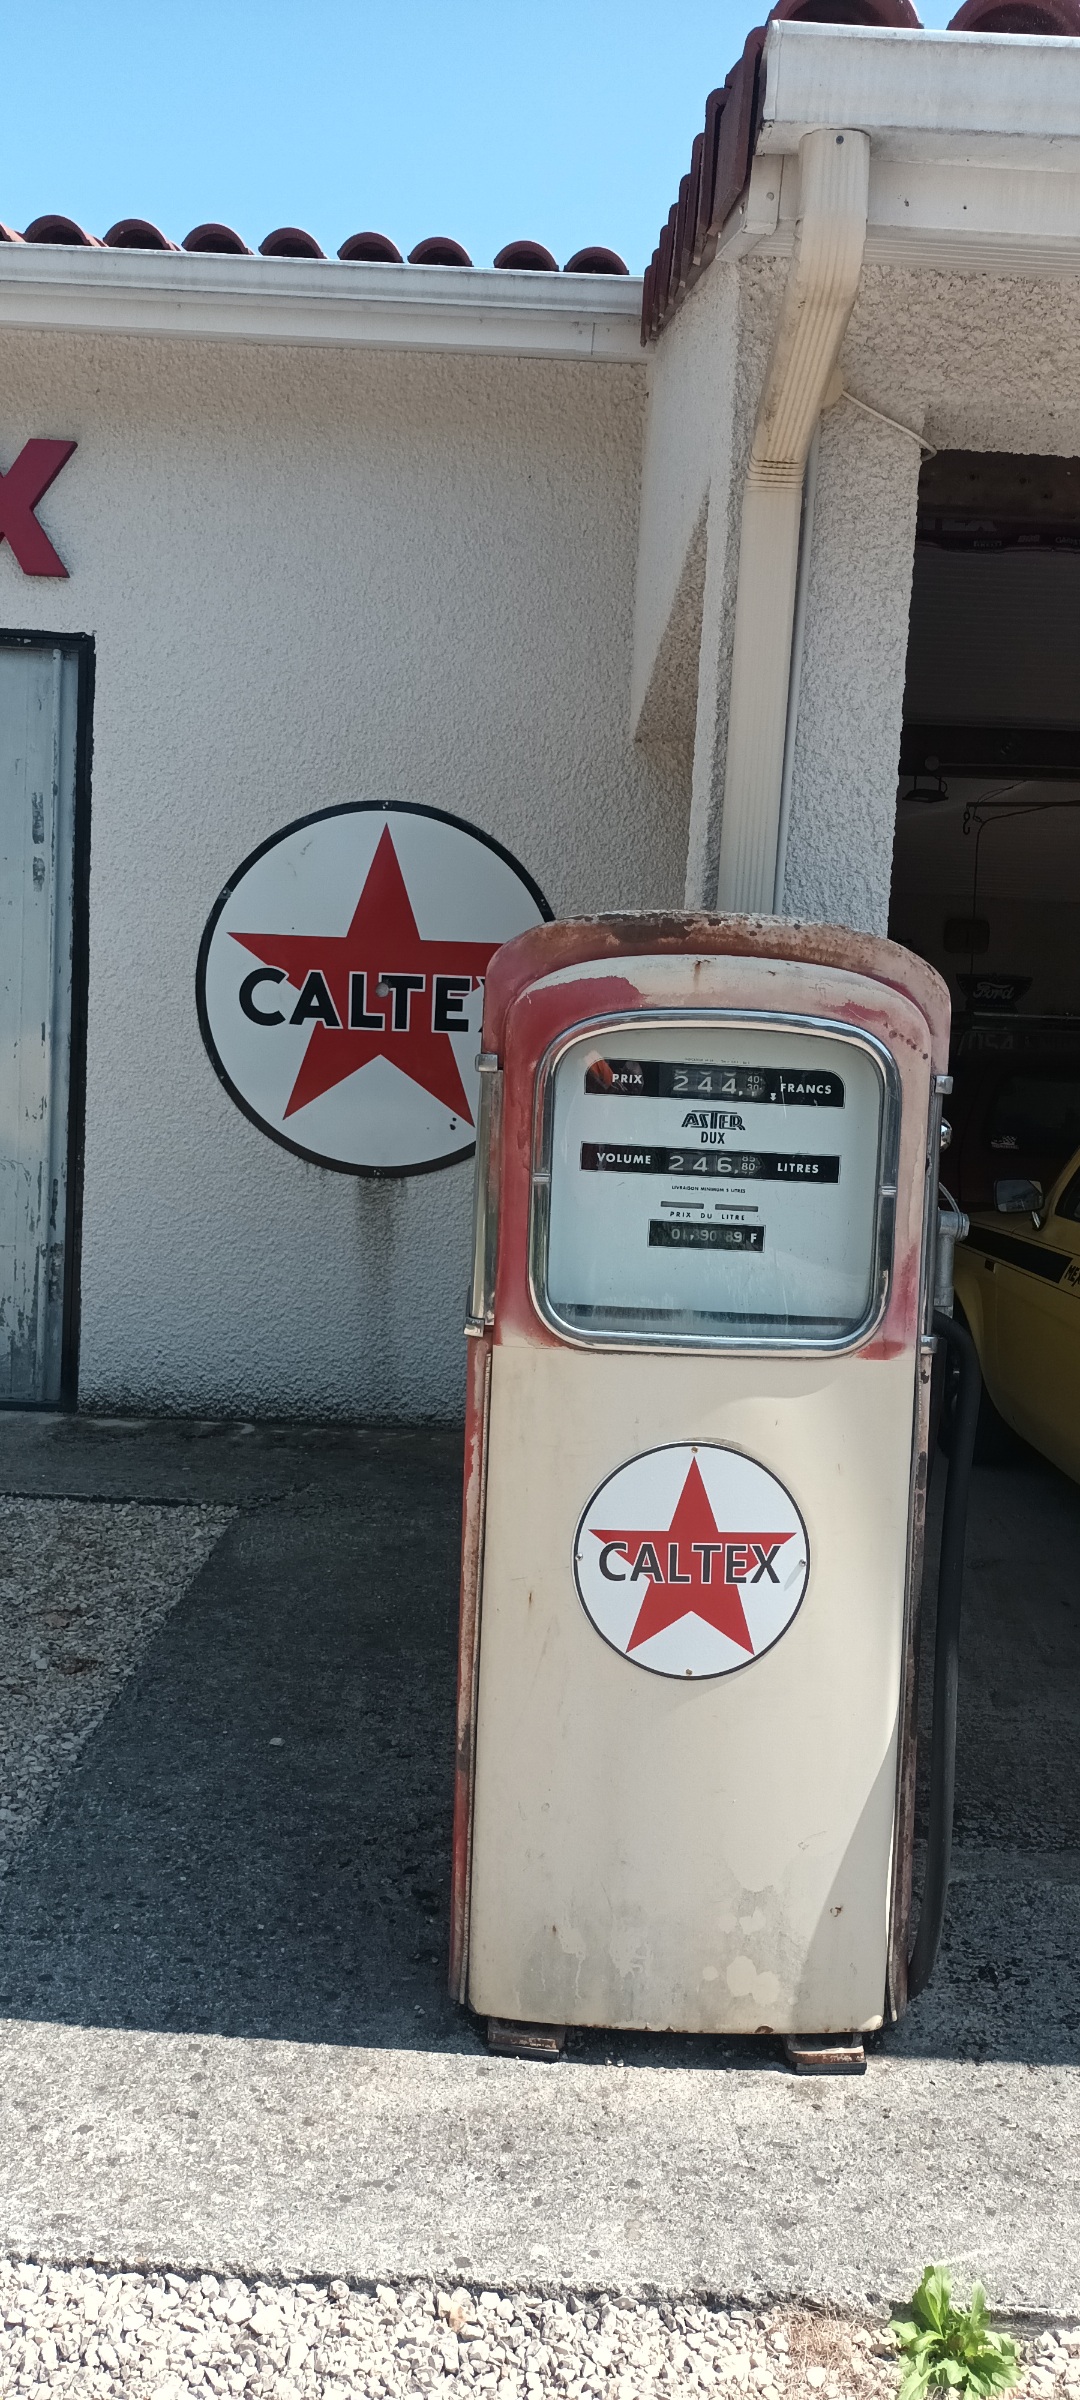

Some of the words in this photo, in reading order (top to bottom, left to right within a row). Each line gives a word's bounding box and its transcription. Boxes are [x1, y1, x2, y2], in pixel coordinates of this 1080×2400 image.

[0, 438, 78, 578] X
[239, 966, 484, 1033] CALTE
[972, 981, 1015, 1000] Ford
[611, 1073, 643, 1085] PRIX
[780, 1082, 832, 1095] FRANCS
[681, 1109, 746, 1131] ASTER
[701, 1131, 726, 1145] DUX
[596, 1152, 651, 1165] VOLUME
[777, 1162, 820, 1174] LITRES
[721, 1213, 745, 1221] LITRE
[750, 1233, 758, 1244] F
[599, 1541, 783, 1584] CALTEX
